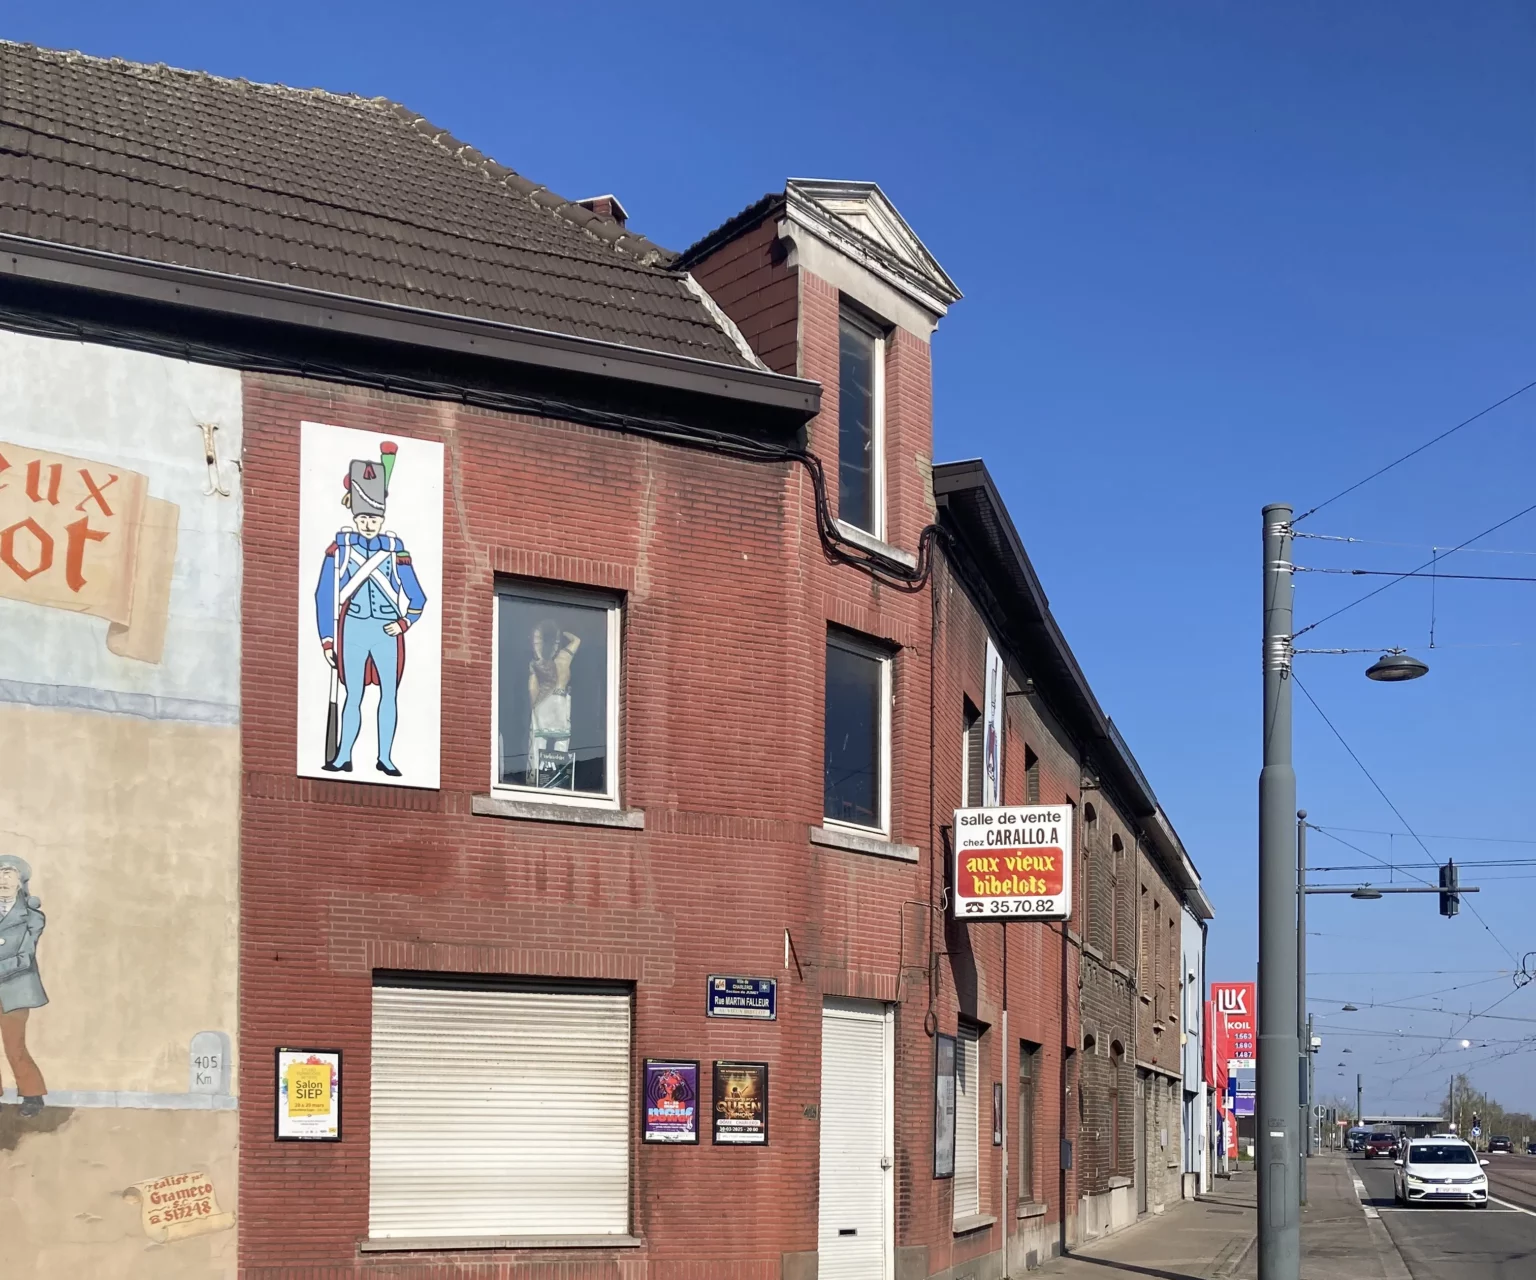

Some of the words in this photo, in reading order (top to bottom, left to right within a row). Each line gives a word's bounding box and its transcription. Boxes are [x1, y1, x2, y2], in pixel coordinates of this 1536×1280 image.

[960, 813, 994, 826] salle
[998, 812, 1016, 824] de
[1020, 811, 1062, 823] vente
[963, 838, 984, 846] chez
[986, 827, 1059, 846] CARALLO.A
[966, 857, 1000, 873] aux
[1003, 851, 1055, 872] vieux
[972, 874, 1047, 895] bibelots
[990, 900, 1054, 914] 35.70.82
[715, 996, 724, 1005] Rue
[725, 996, 746, 1006] MARTIN
[746, 998, 769, 1007] FALLEUR
[194, 1056, 218, 1069] 405
[196, 1072, 212, 1085] Km
[296, 1080, 322, 1089] Salon
[296, 1089, 322, 1099] SIEP
[716, 1101, 761, 1113] QUEEN
